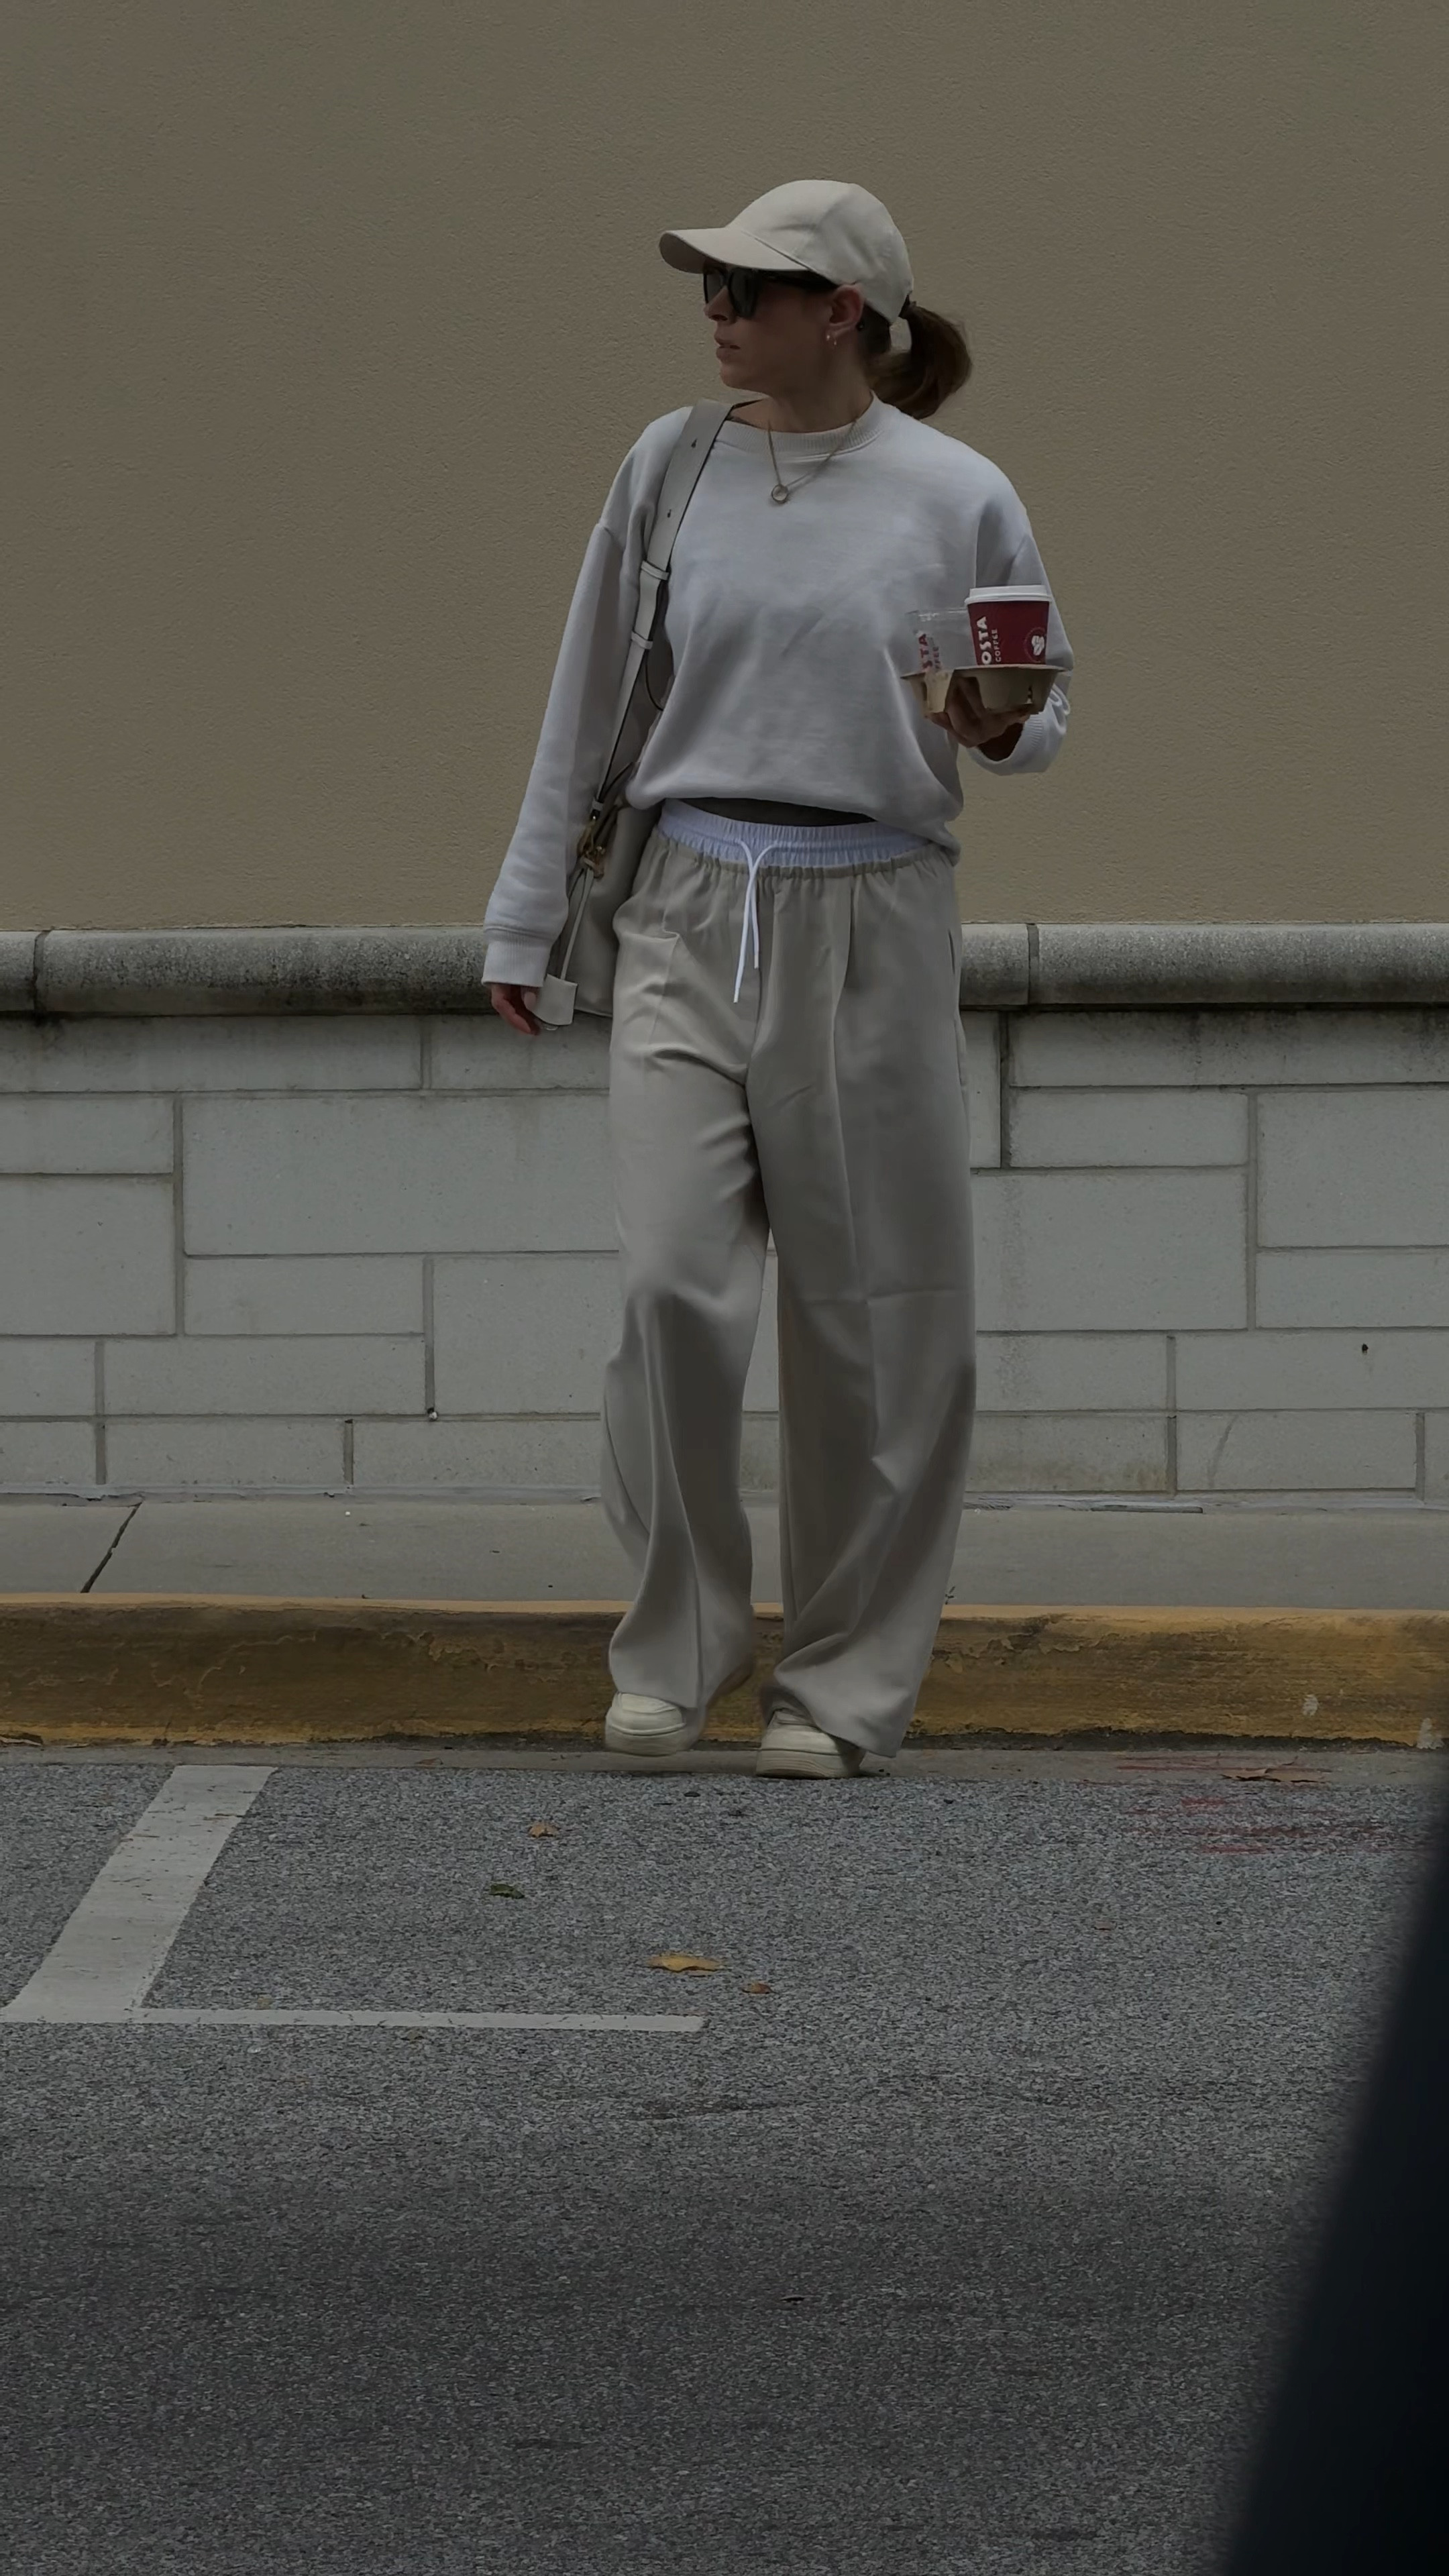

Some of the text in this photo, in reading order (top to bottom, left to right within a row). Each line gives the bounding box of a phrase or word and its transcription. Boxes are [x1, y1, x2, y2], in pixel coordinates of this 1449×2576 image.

[918, 633, 932, 669] STA
[932, 646, 941, 669] FFEE
[976, 616, 991, 665] OSTA
[991, 628, 1002, 662] COFFEE
